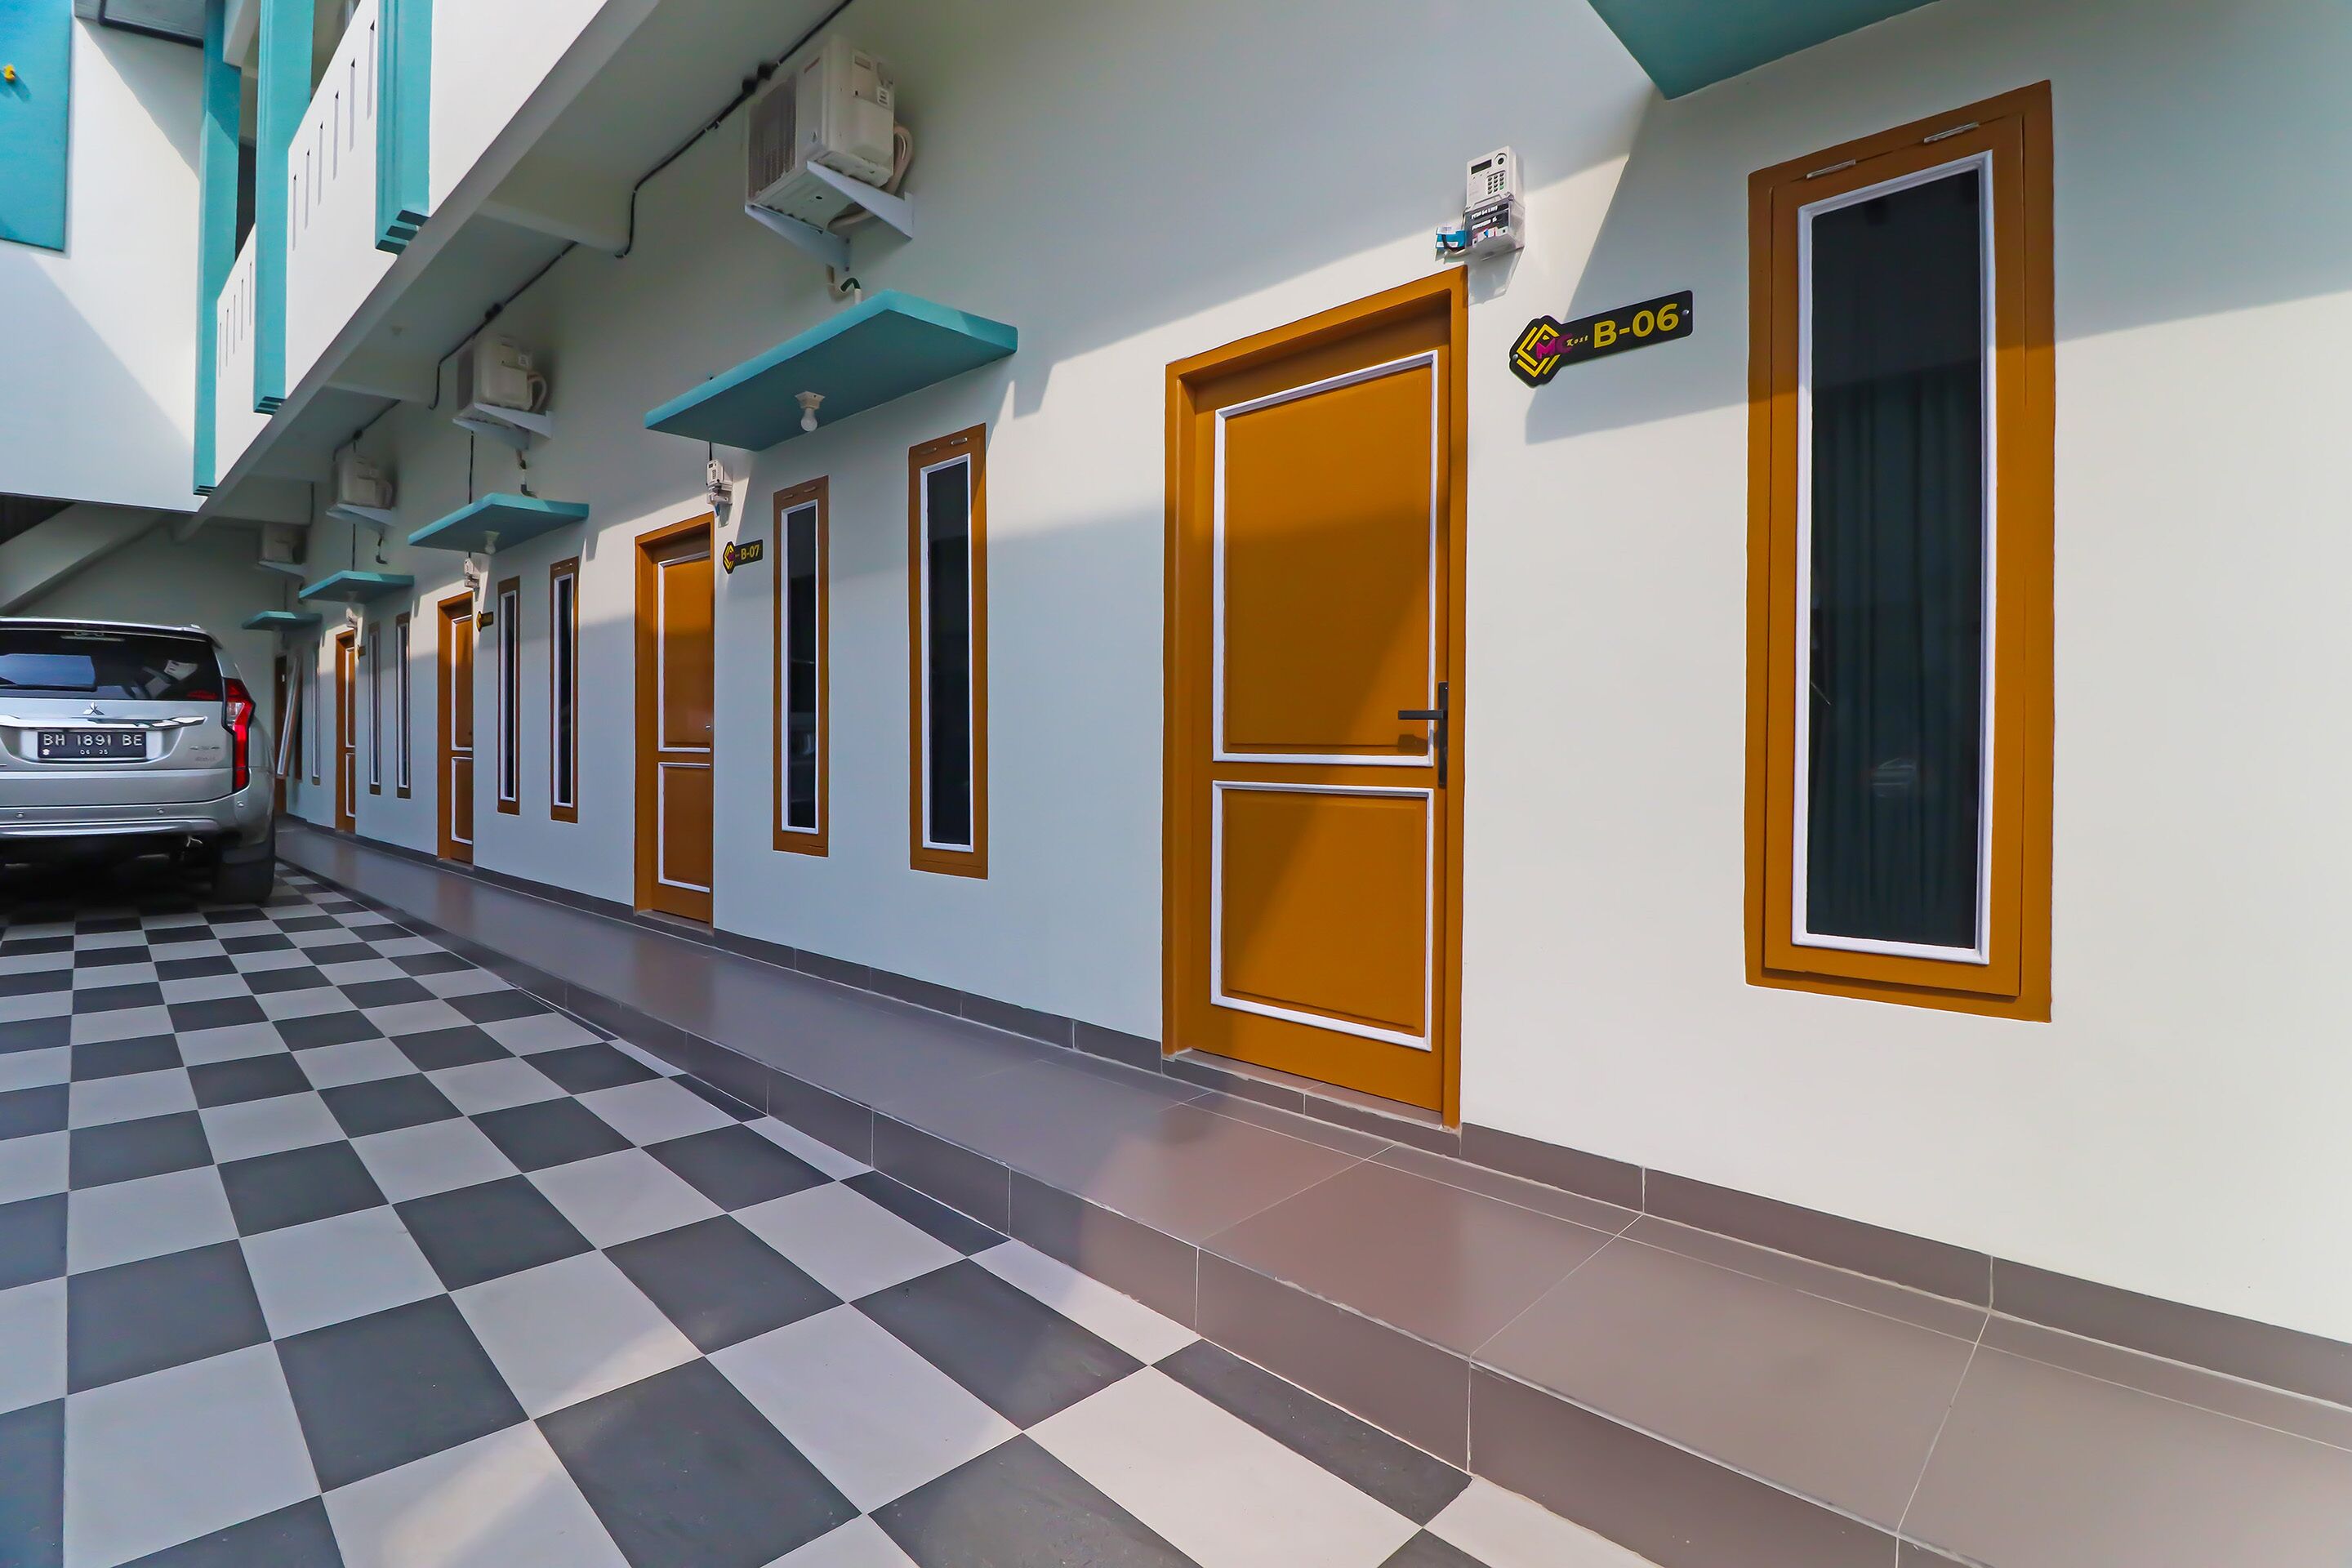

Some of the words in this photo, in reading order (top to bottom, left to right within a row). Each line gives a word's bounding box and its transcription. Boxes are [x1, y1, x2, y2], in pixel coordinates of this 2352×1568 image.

[1566, 335, 1588, 347] Kost
[1593, 303, 1679, 349] B-06
[741, 545, 760, 560] B-07
[43, 734, 65, 746] BH
[78, 734, 112, 746] 1891
[122, 734, 143, 746] BE
